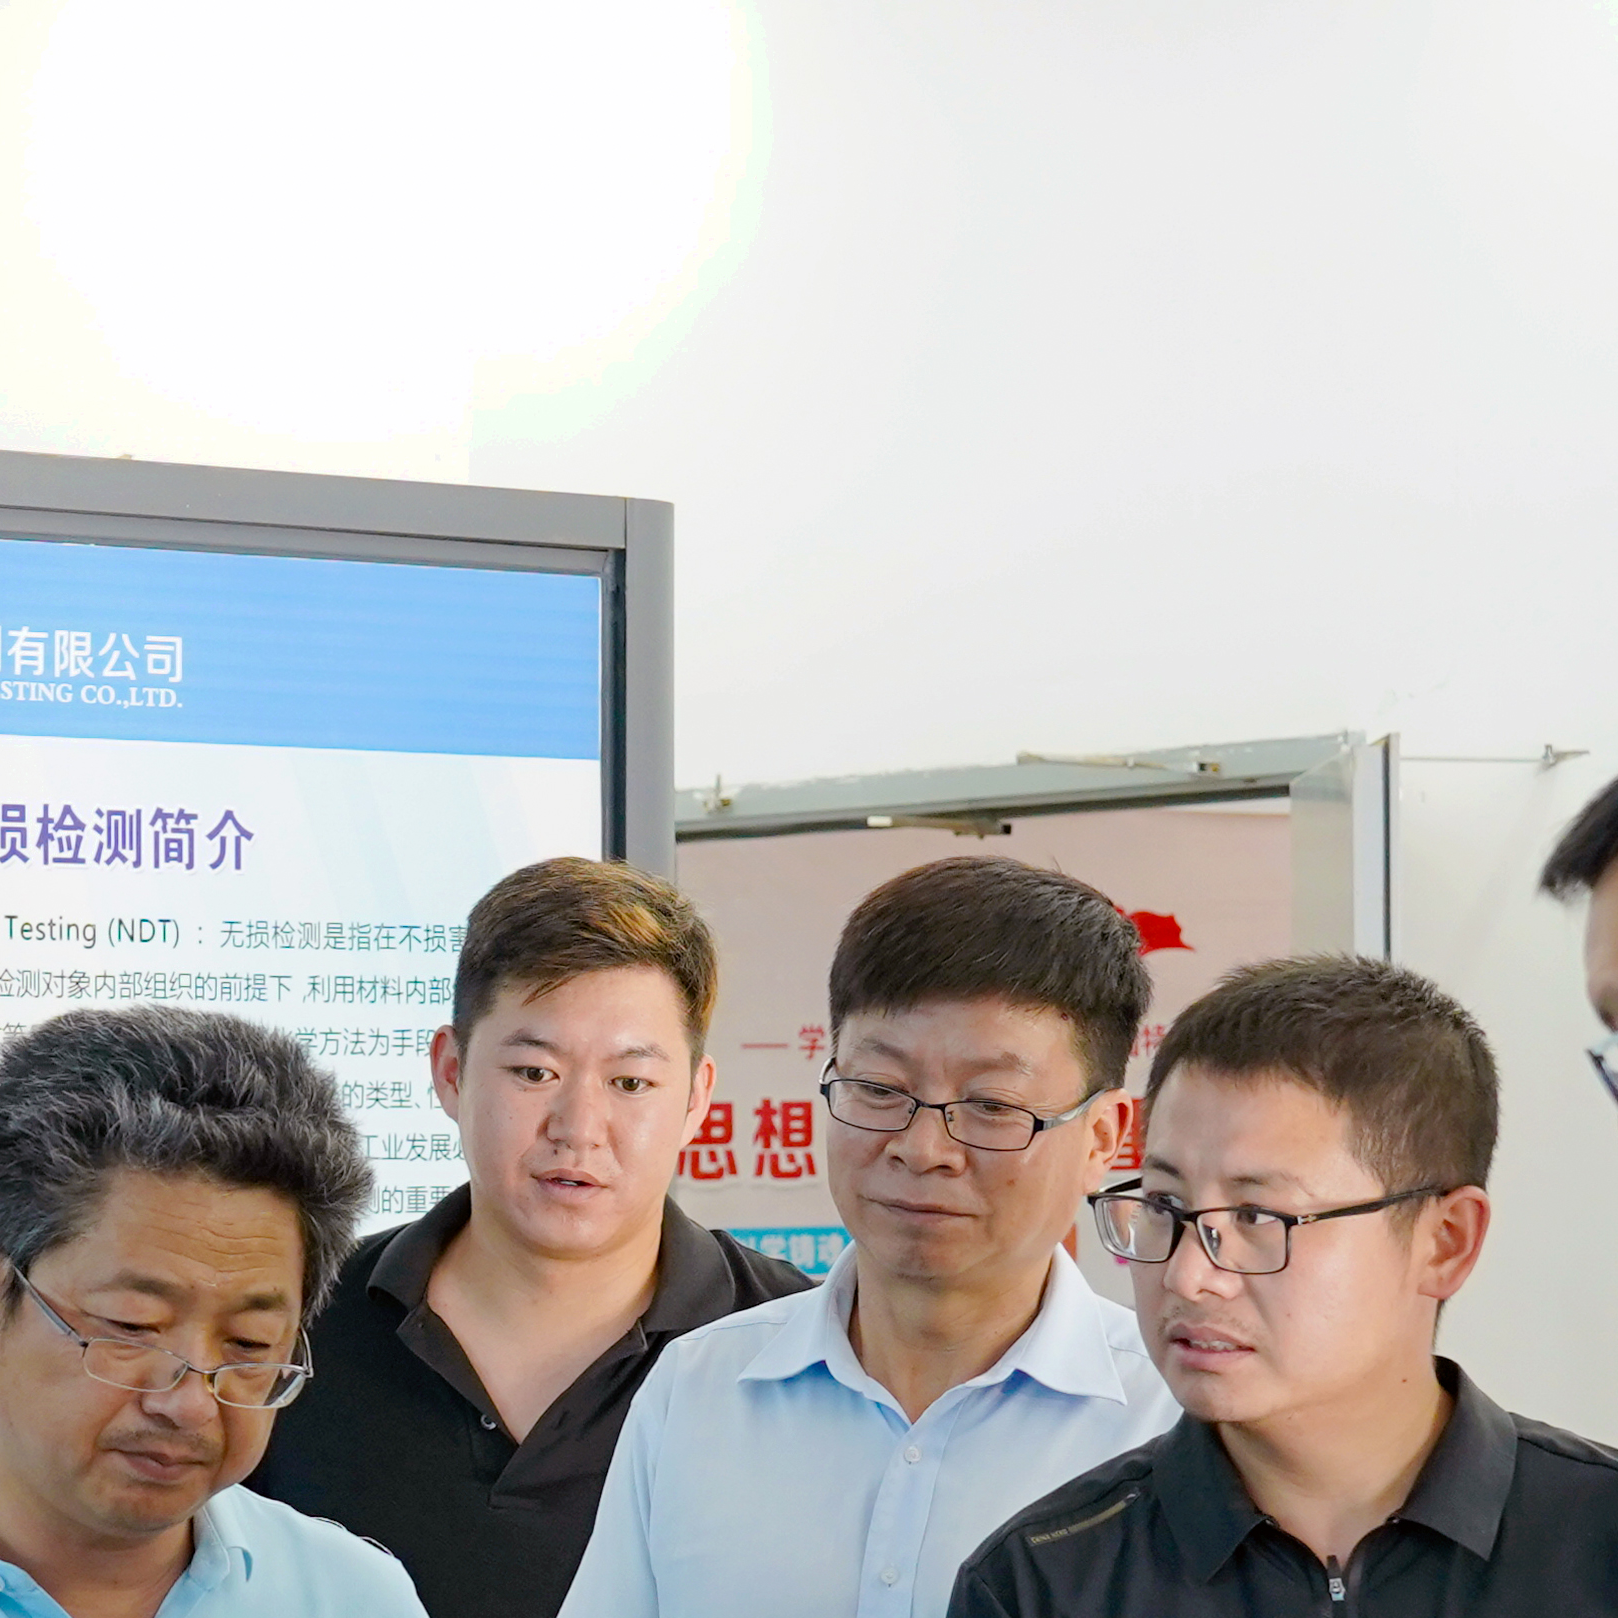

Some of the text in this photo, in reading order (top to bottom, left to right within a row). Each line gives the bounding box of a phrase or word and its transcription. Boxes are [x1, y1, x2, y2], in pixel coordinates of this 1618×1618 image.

[80, 685, 183, 709] CO.,LTD.
[5, 914, 97, 949] Testing
[677, 1098, 817, 1180] 思想
